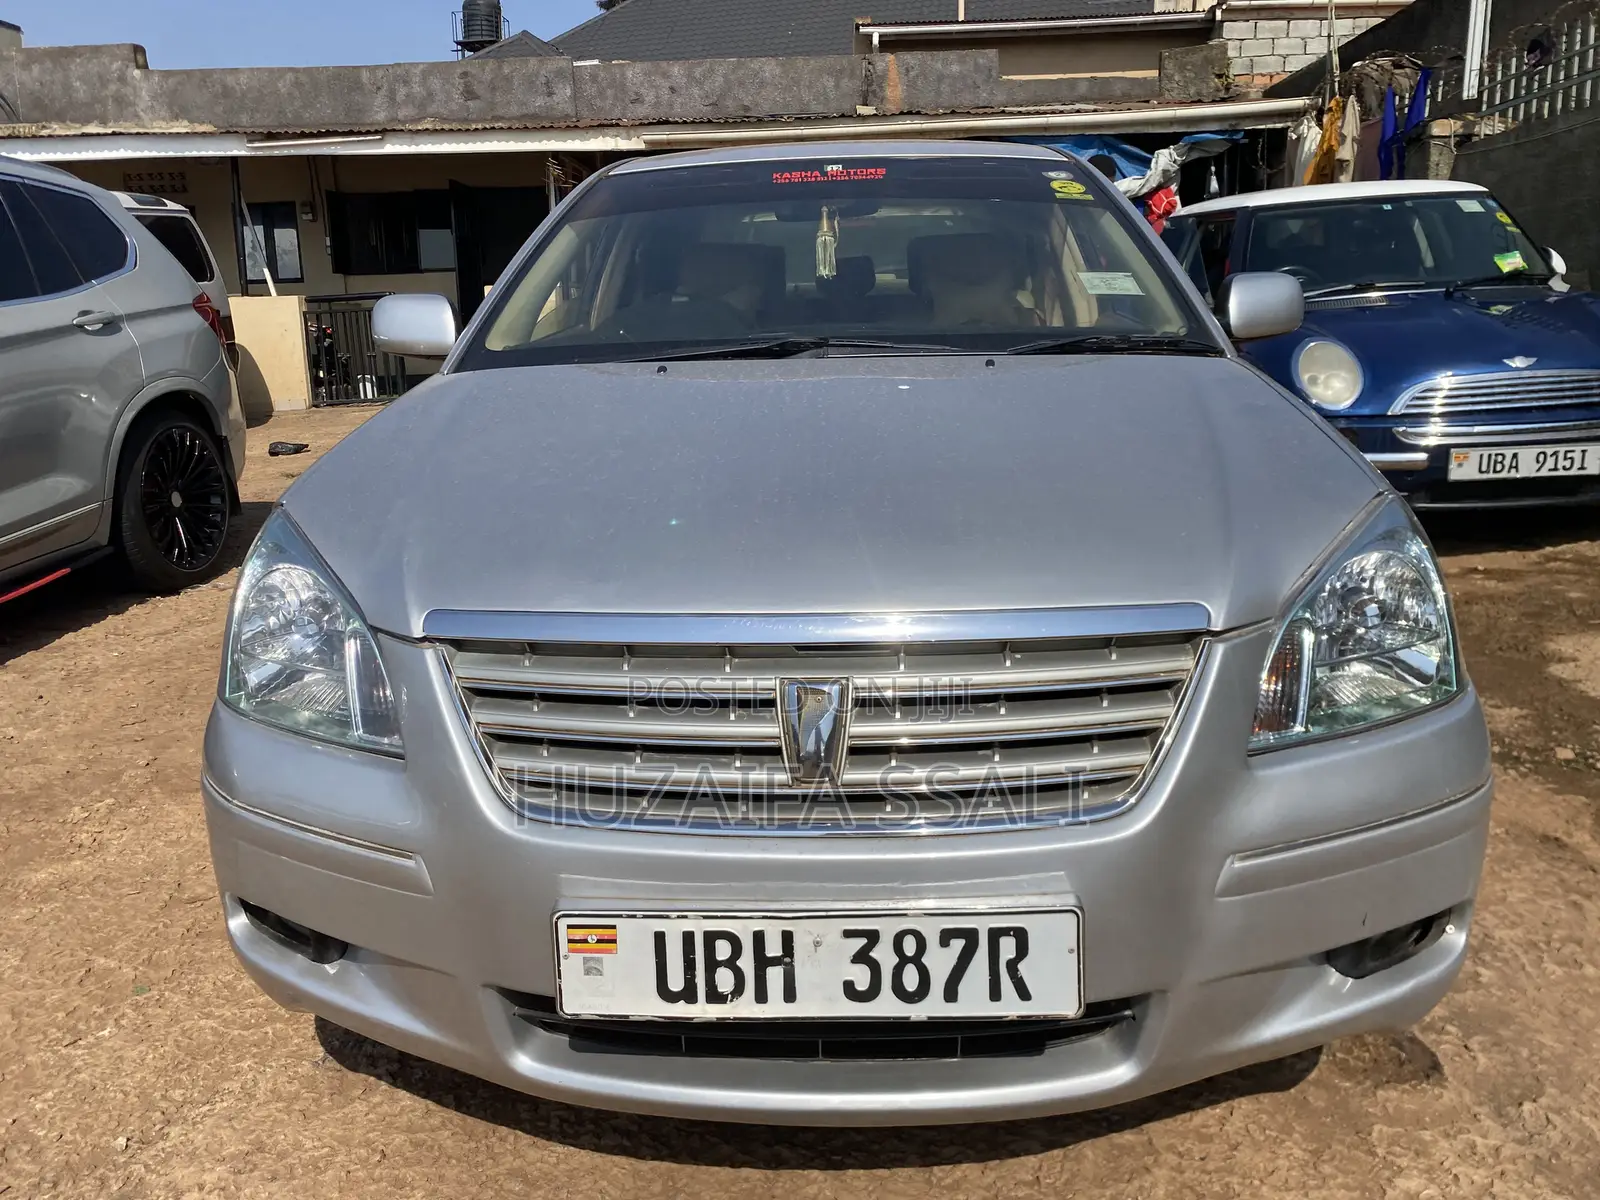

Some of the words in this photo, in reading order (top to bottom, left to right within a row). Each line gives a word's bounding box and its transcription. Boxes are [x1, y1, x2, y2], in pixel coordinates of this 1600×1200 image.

[772, 170, 821, 179] KASHA
[827, 168, 886, 176] MOTORS
[1478, 452, 1519, 474] UBA
[1535, 449, 1588, 473] 915I
[653, 929, 797, 1004] UBH
[842, 926, 1033, 1004] 387R
